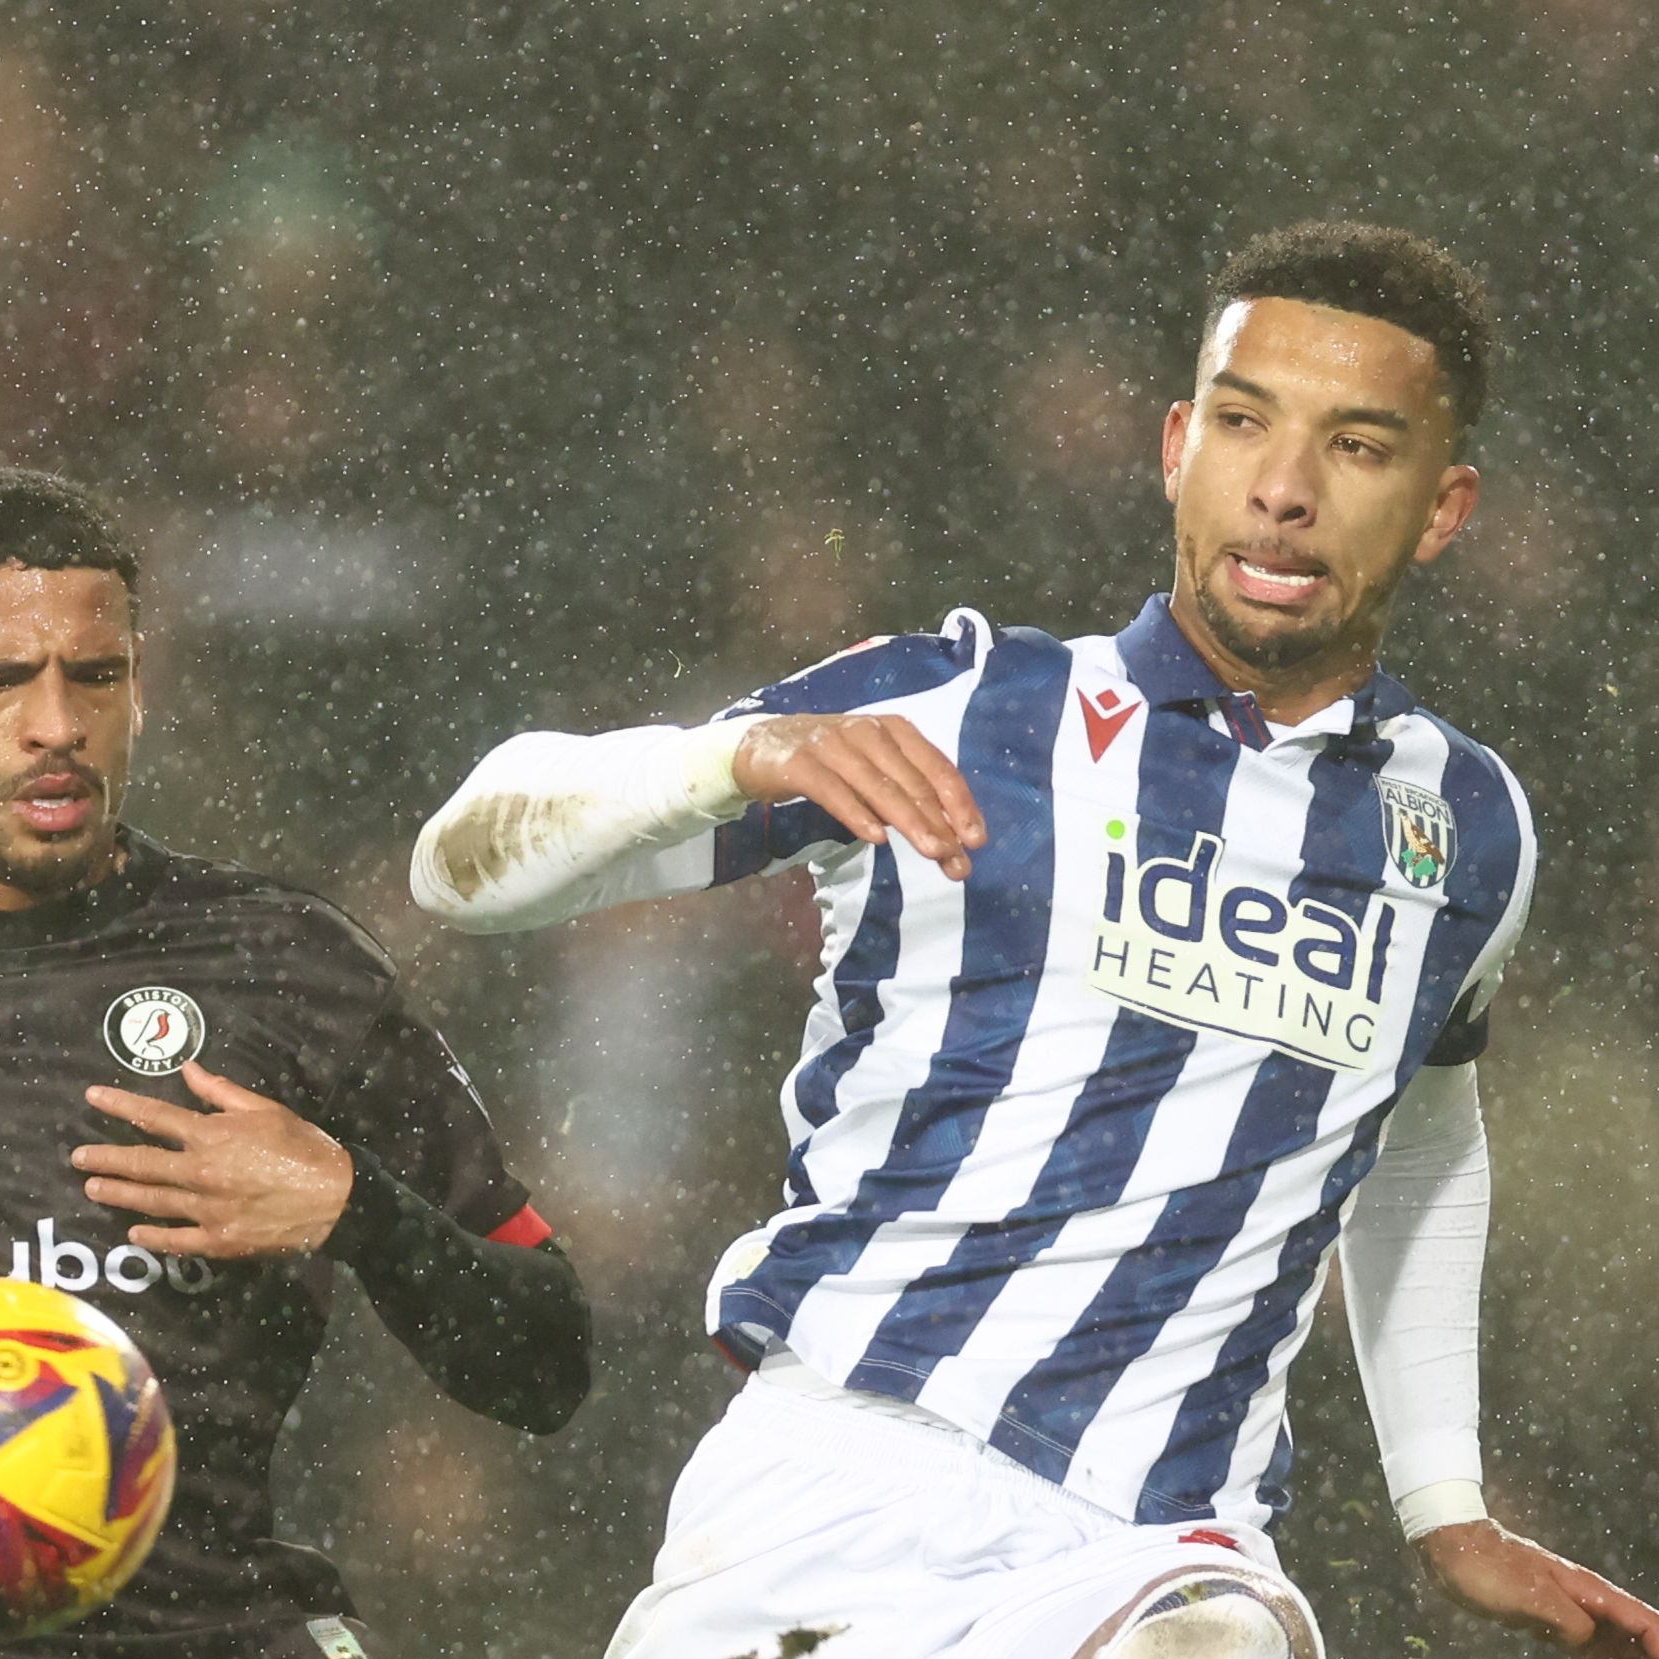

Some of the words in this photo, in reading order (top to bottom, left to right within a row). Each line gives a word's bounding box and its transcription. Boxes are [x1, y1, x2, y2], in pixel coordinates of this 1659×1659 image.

[1385, 788, 1451, 825] ALBION
[1103, 819, 1396, 1005] ideal
[123, 991, 188, 1012] BRISTOL
[1093, 935, 1375, 1052] HEATING
[131, 1057, 172, 1071] CITY
